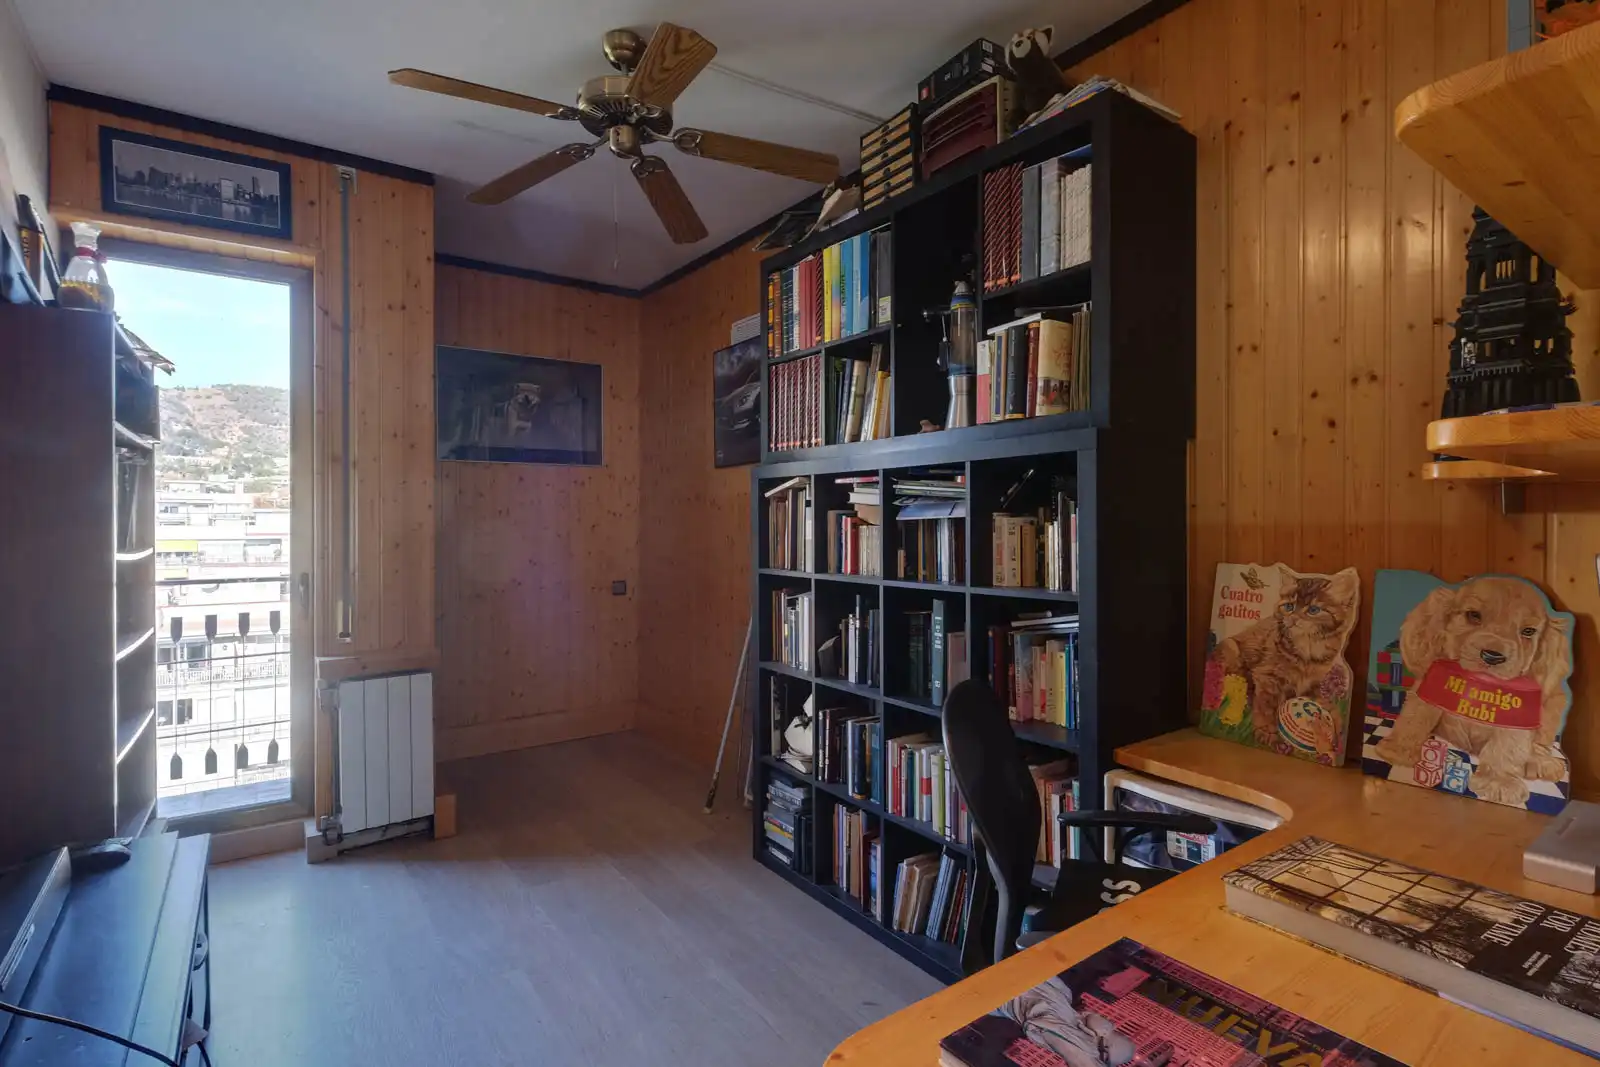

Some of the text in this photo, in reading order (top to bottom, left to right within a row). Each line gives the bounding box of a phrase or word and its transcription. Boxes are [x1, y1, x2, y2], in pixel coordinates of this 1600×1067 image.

[1220, 585, 1263, 604] Cuatro
[1218, 604, 1261, 620] gatitos
[1444, 675, 1522, 710] Mi amigo
[1457, 698, 1497, 722] Bubi
[1480, 901, 1546, 947] OUR TIME
[1540, 910, 1582, 932] FOR
